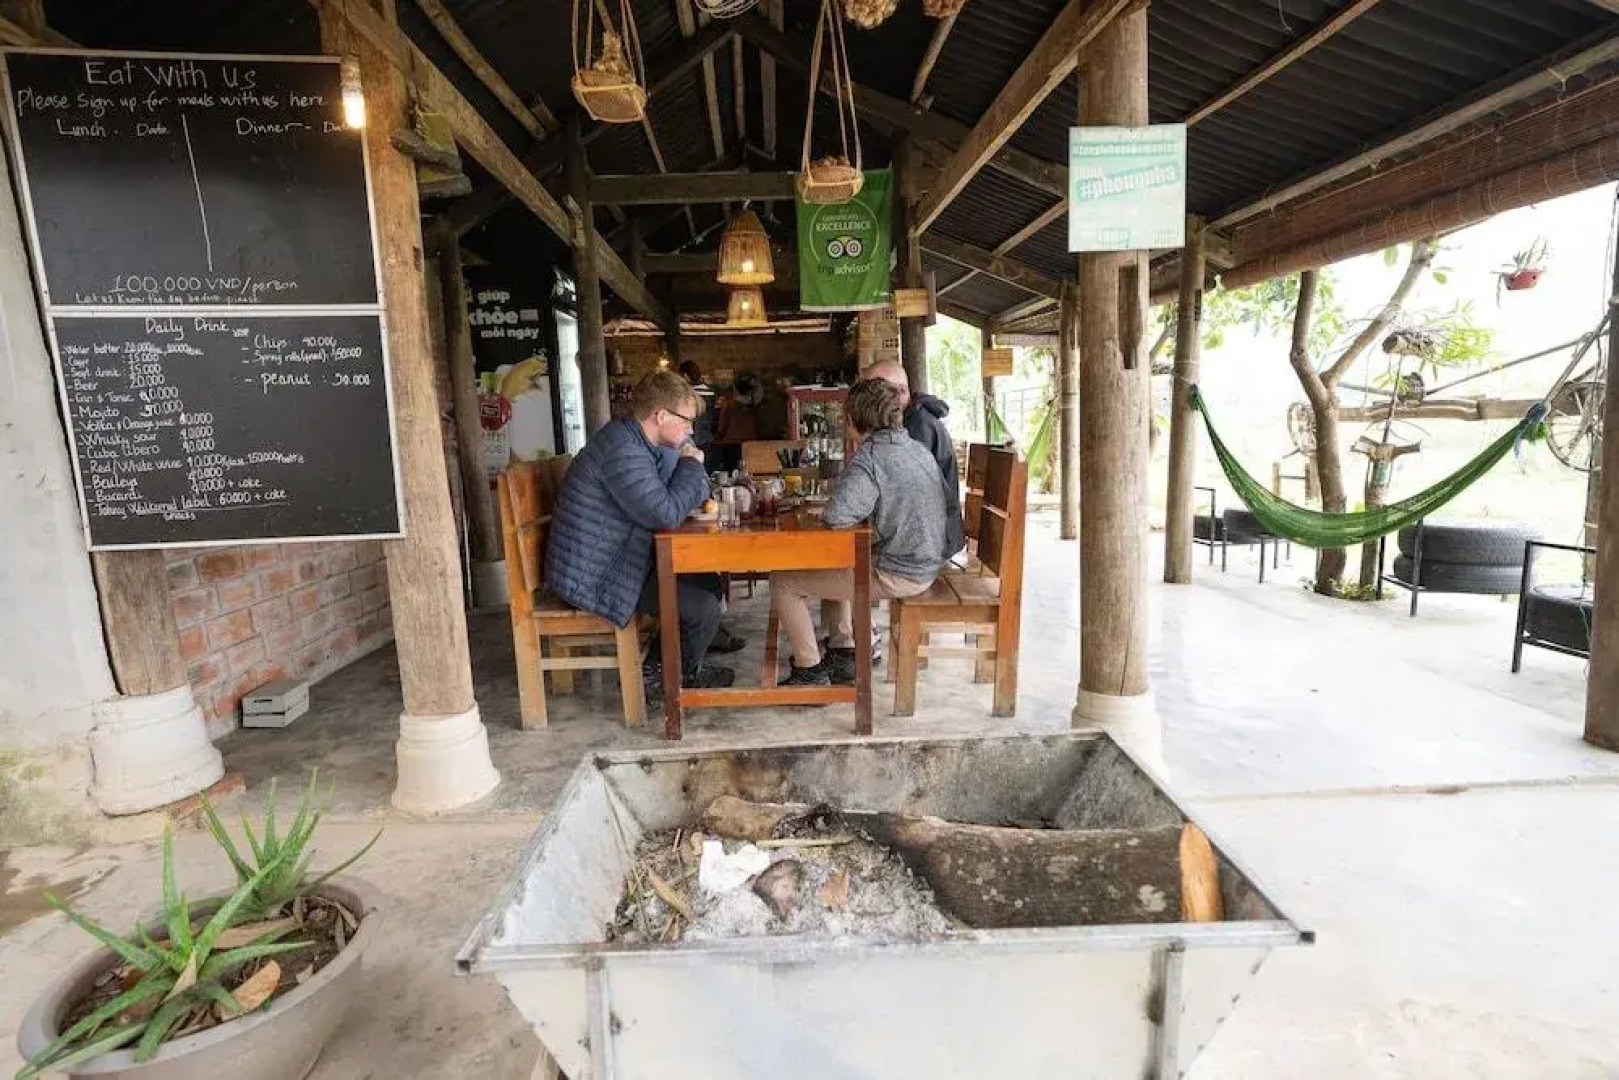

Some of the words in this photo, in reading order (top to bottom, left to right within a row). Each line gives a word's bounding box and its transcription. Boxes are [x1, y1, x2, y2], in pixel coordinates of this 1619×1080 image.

[86, 61, 136, 84] Eat
[144, 60, 207, 88] With
[222, 66, 256, 90] Us
[18, 87, 70, 117] Please
[77, 94, 116, 118] Sign
[120, 97, 135, 112] up
[143, 90, 169, 112] for
[178, 92, 215, 107] meals
[221, 91, 261, 106] with
[261, 95, 279, 109] us
[290, 91, 329, 107] here
[56, 119, 107, 137] Lunch
[136, 123, 169, 137] Date
[815, 221, 873, 232] EXCELLENCE
[144, 317, 184, 341] Daily
[194, 316, 229, 331] Drink
